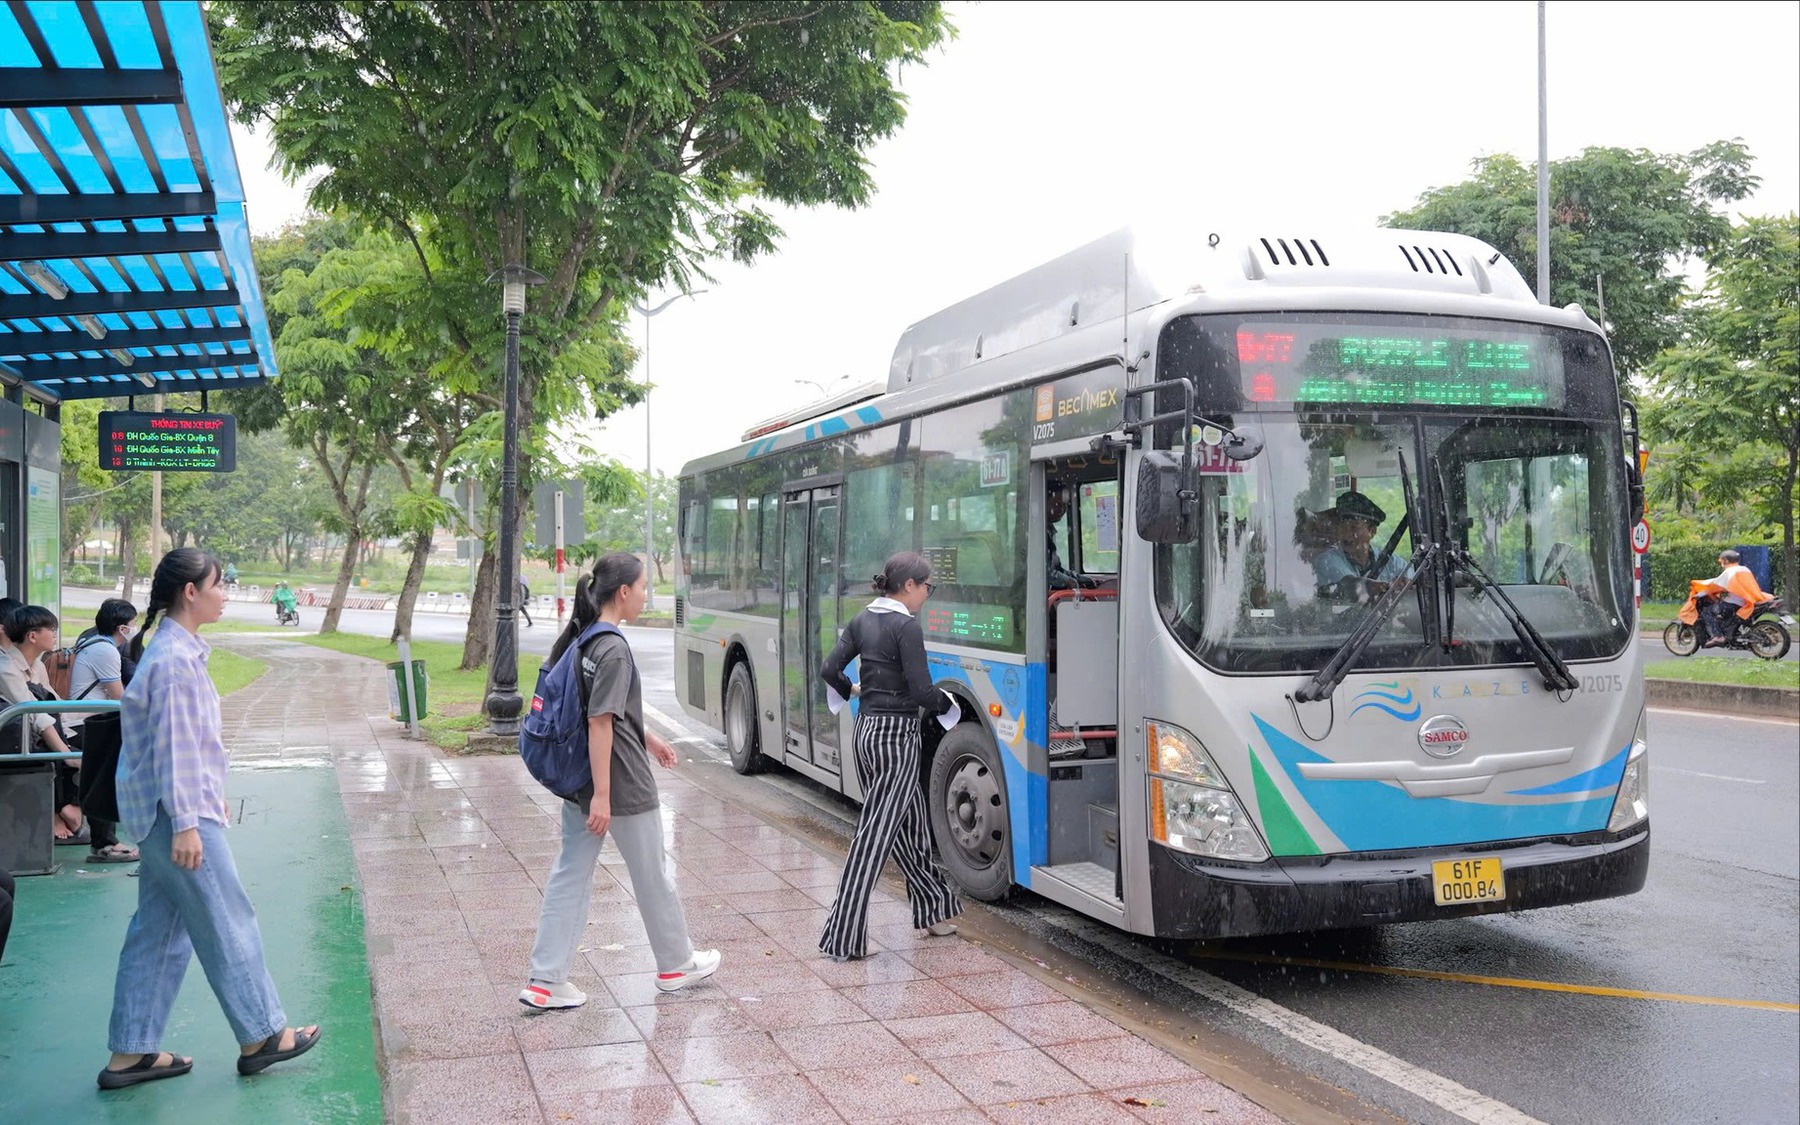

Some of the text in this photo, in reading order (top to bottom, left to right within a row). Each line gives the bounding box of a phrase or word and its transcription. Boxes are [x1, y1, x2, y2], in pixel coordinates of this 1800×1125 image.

[1343, 337, 1530, 369] PURPLE LINE
[1033, 422, 1055, 440] V2075
[1635, 528, 1645, 543] 40
[1424, 730, 1467, 743] SAMCO
[1453, 861, 1482, 879] 61F
[1442, 880, 1497, 901] 000.84
